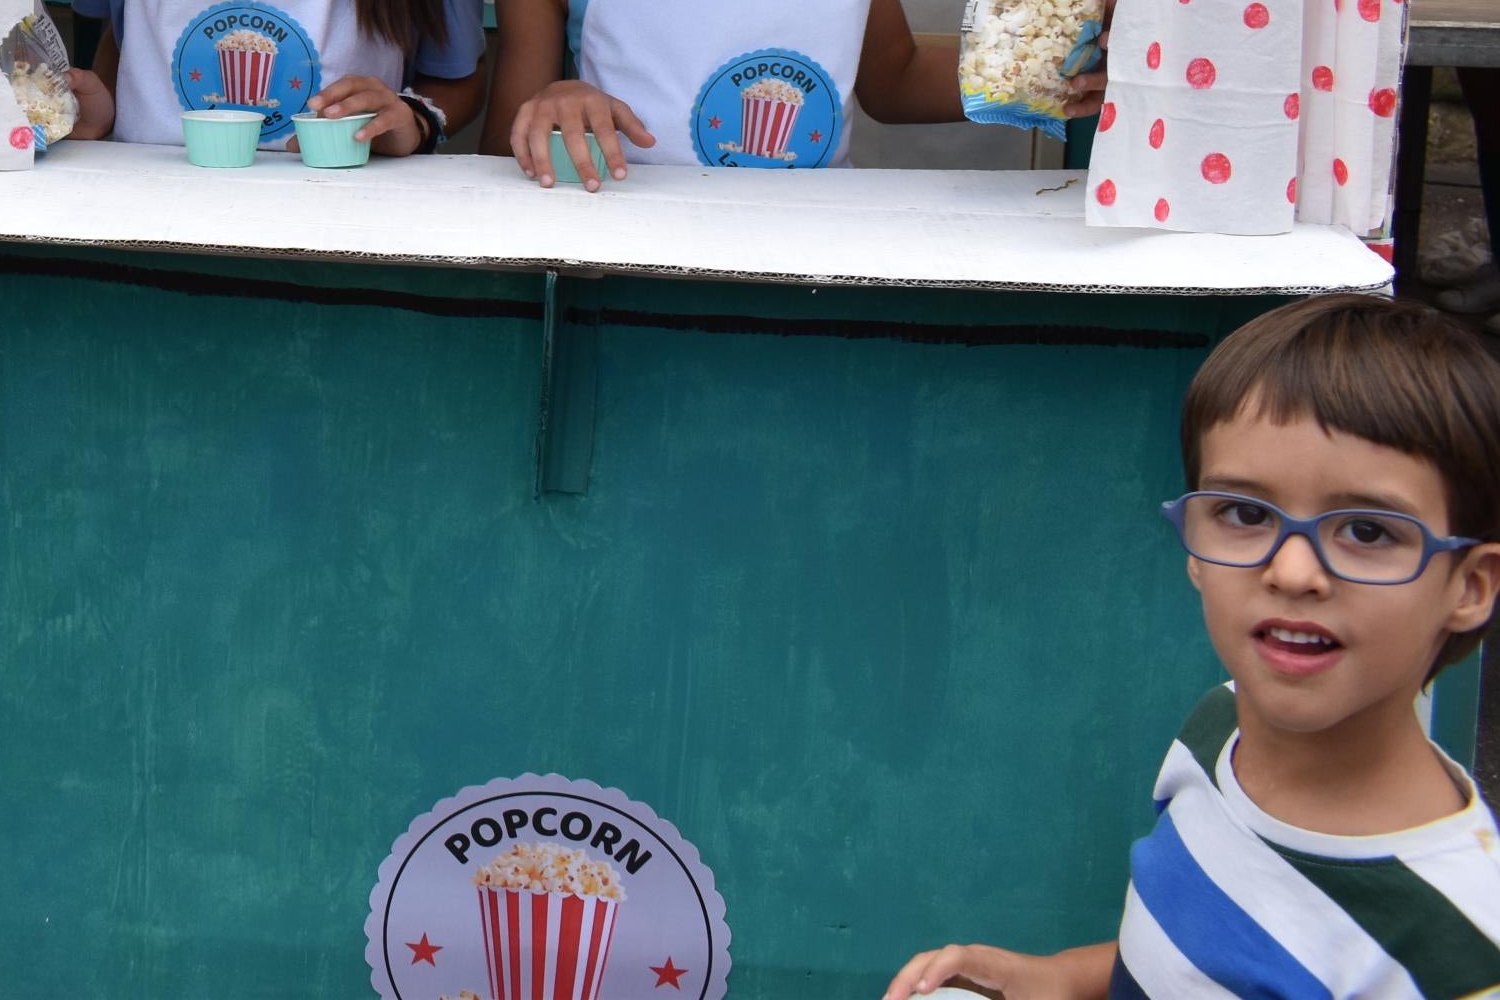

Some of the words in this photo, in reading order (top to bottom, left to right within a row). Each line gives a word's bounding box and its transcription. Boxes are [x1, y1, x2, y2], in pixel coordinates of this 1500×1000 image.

[203, 13, 289, 44] POPCORN
[730, 62, 818, 95] POPCORN
[444, 807, 653, 875] POPCORN
